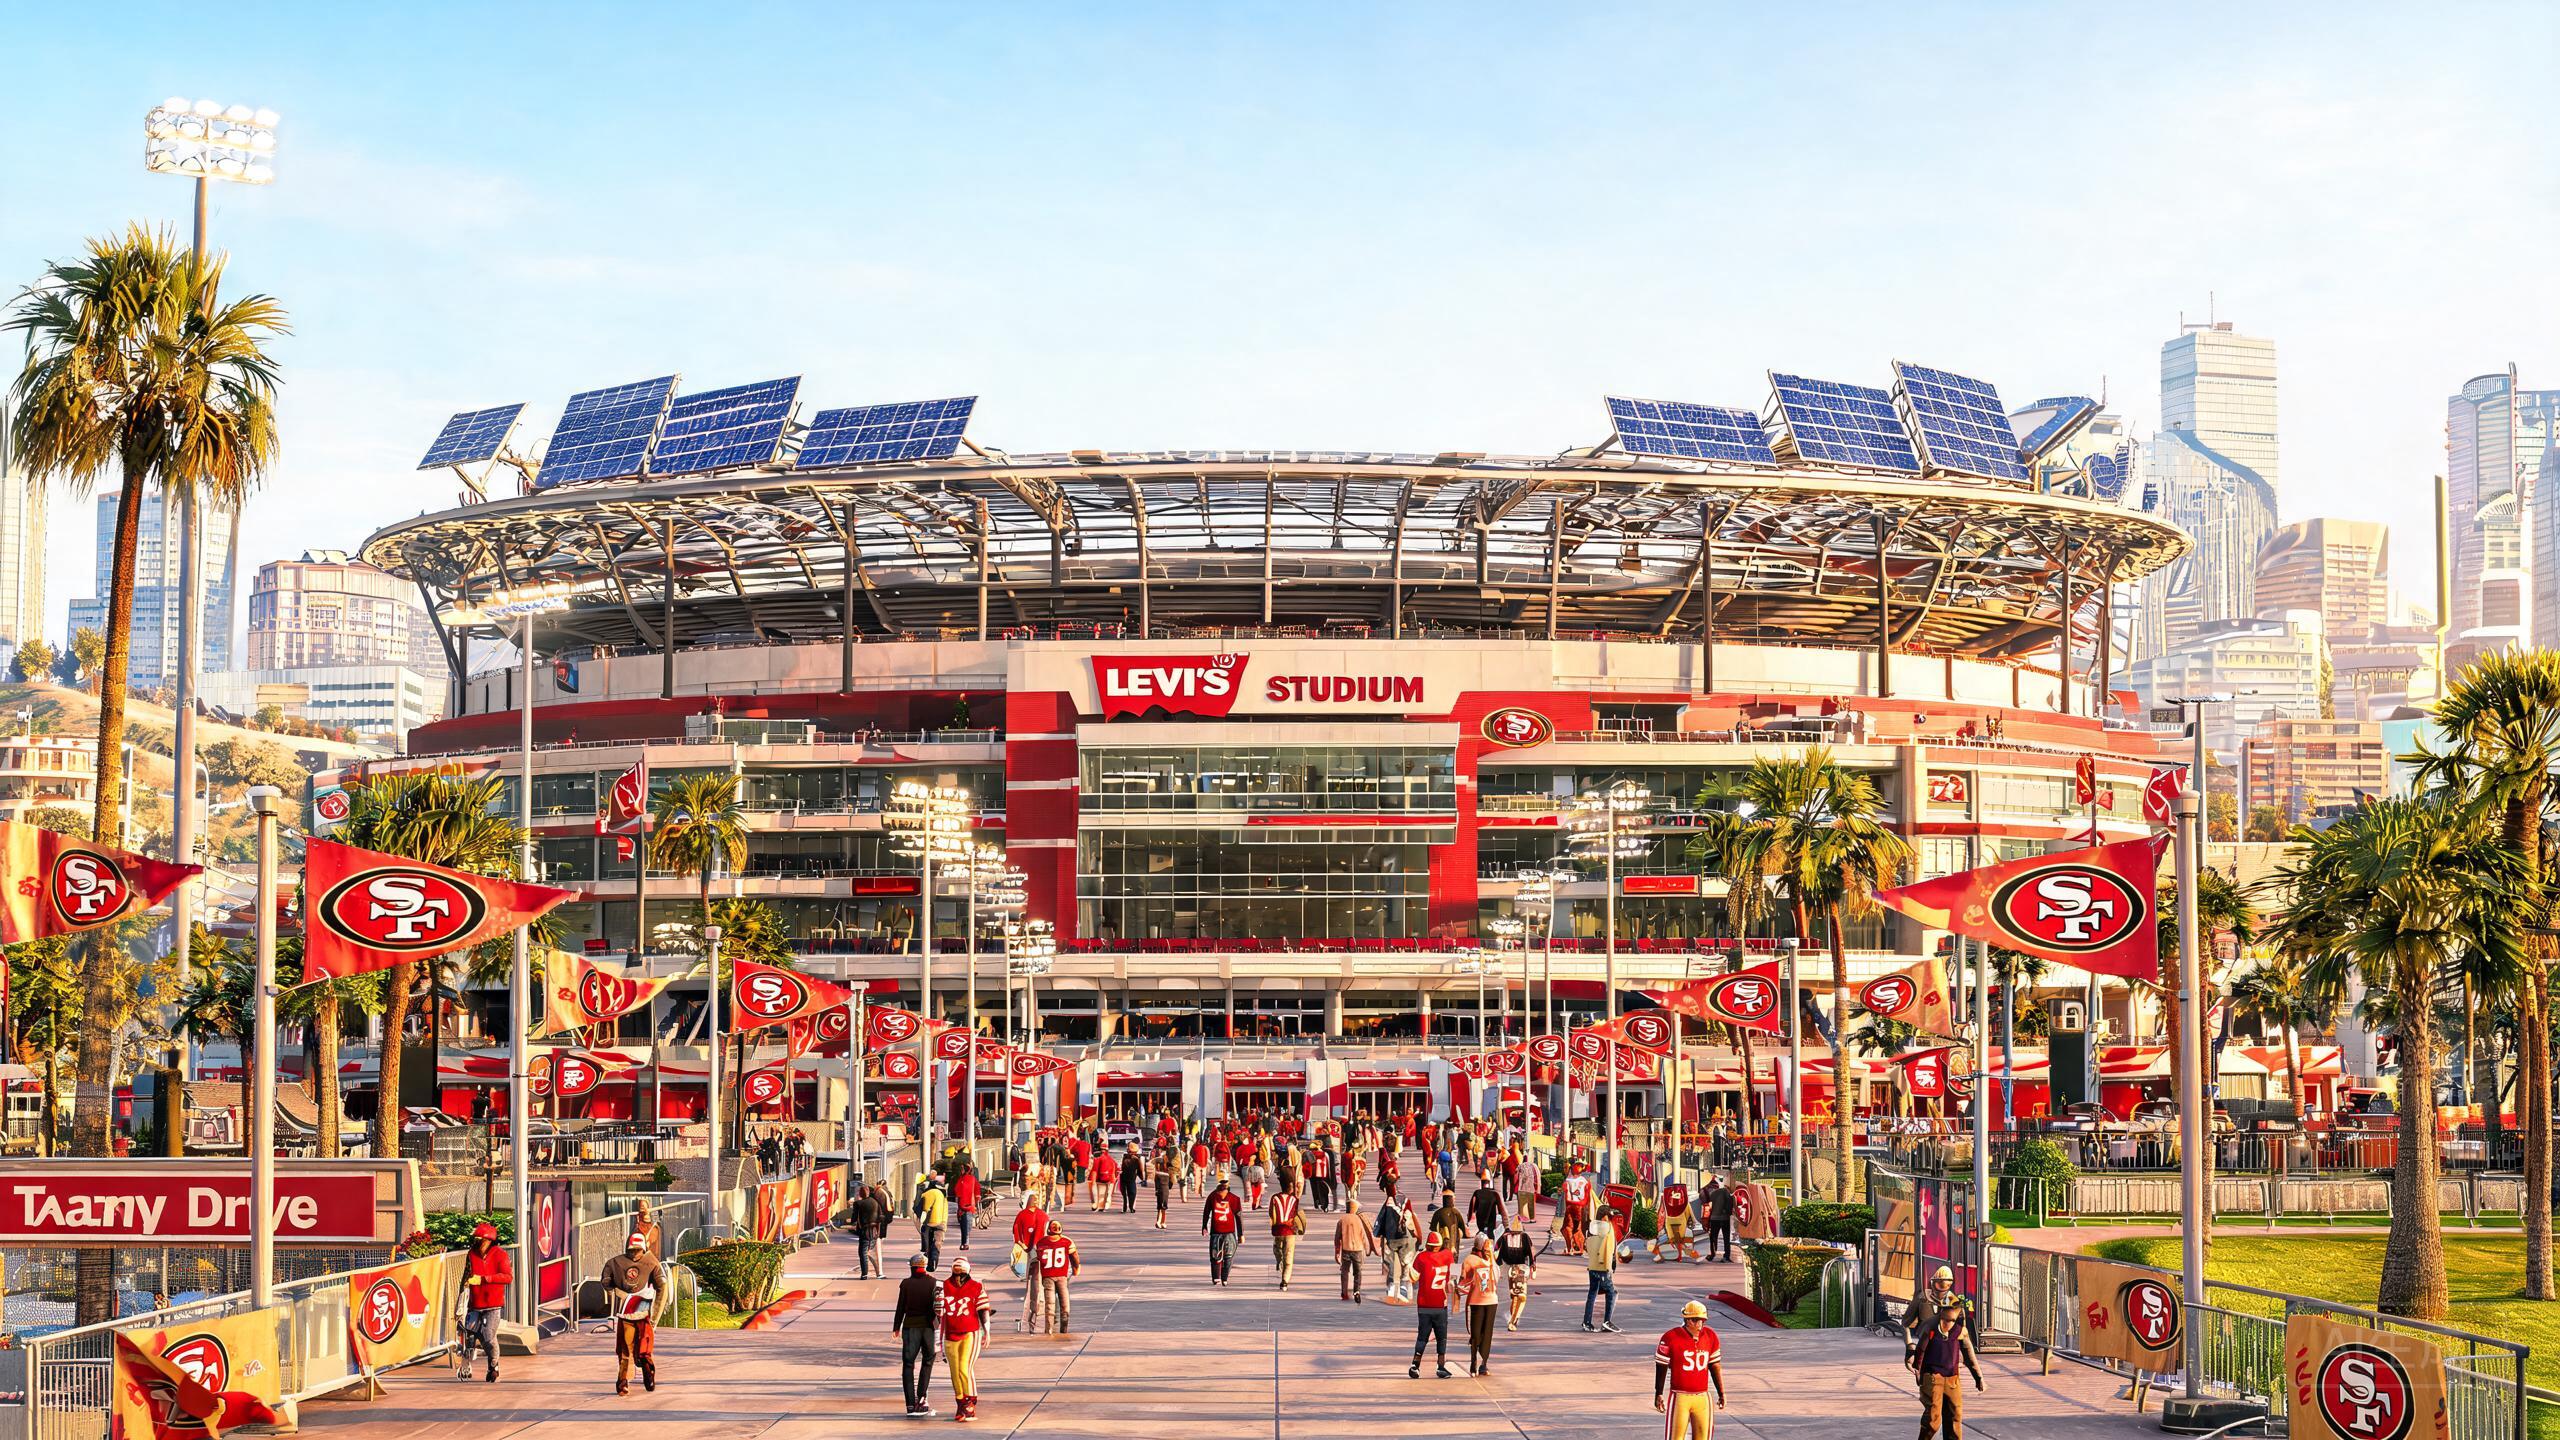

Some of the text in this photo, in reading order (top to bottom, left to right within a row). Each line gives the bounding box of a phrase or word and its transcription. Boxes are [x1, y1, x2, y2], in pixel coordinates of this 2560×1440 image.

[1106, 667, 1424, 703] LEVI'S STUDIUM
[65, 858, 116, 914] SF
[368, 877, 449, 940] SF
[2037, 875, 2113, 940] SF
[188, 1187, 318, 1230] Drve
[1682, 1350, 1710, 1371] 50
[2339, 1358, 2391, 1433] SF
